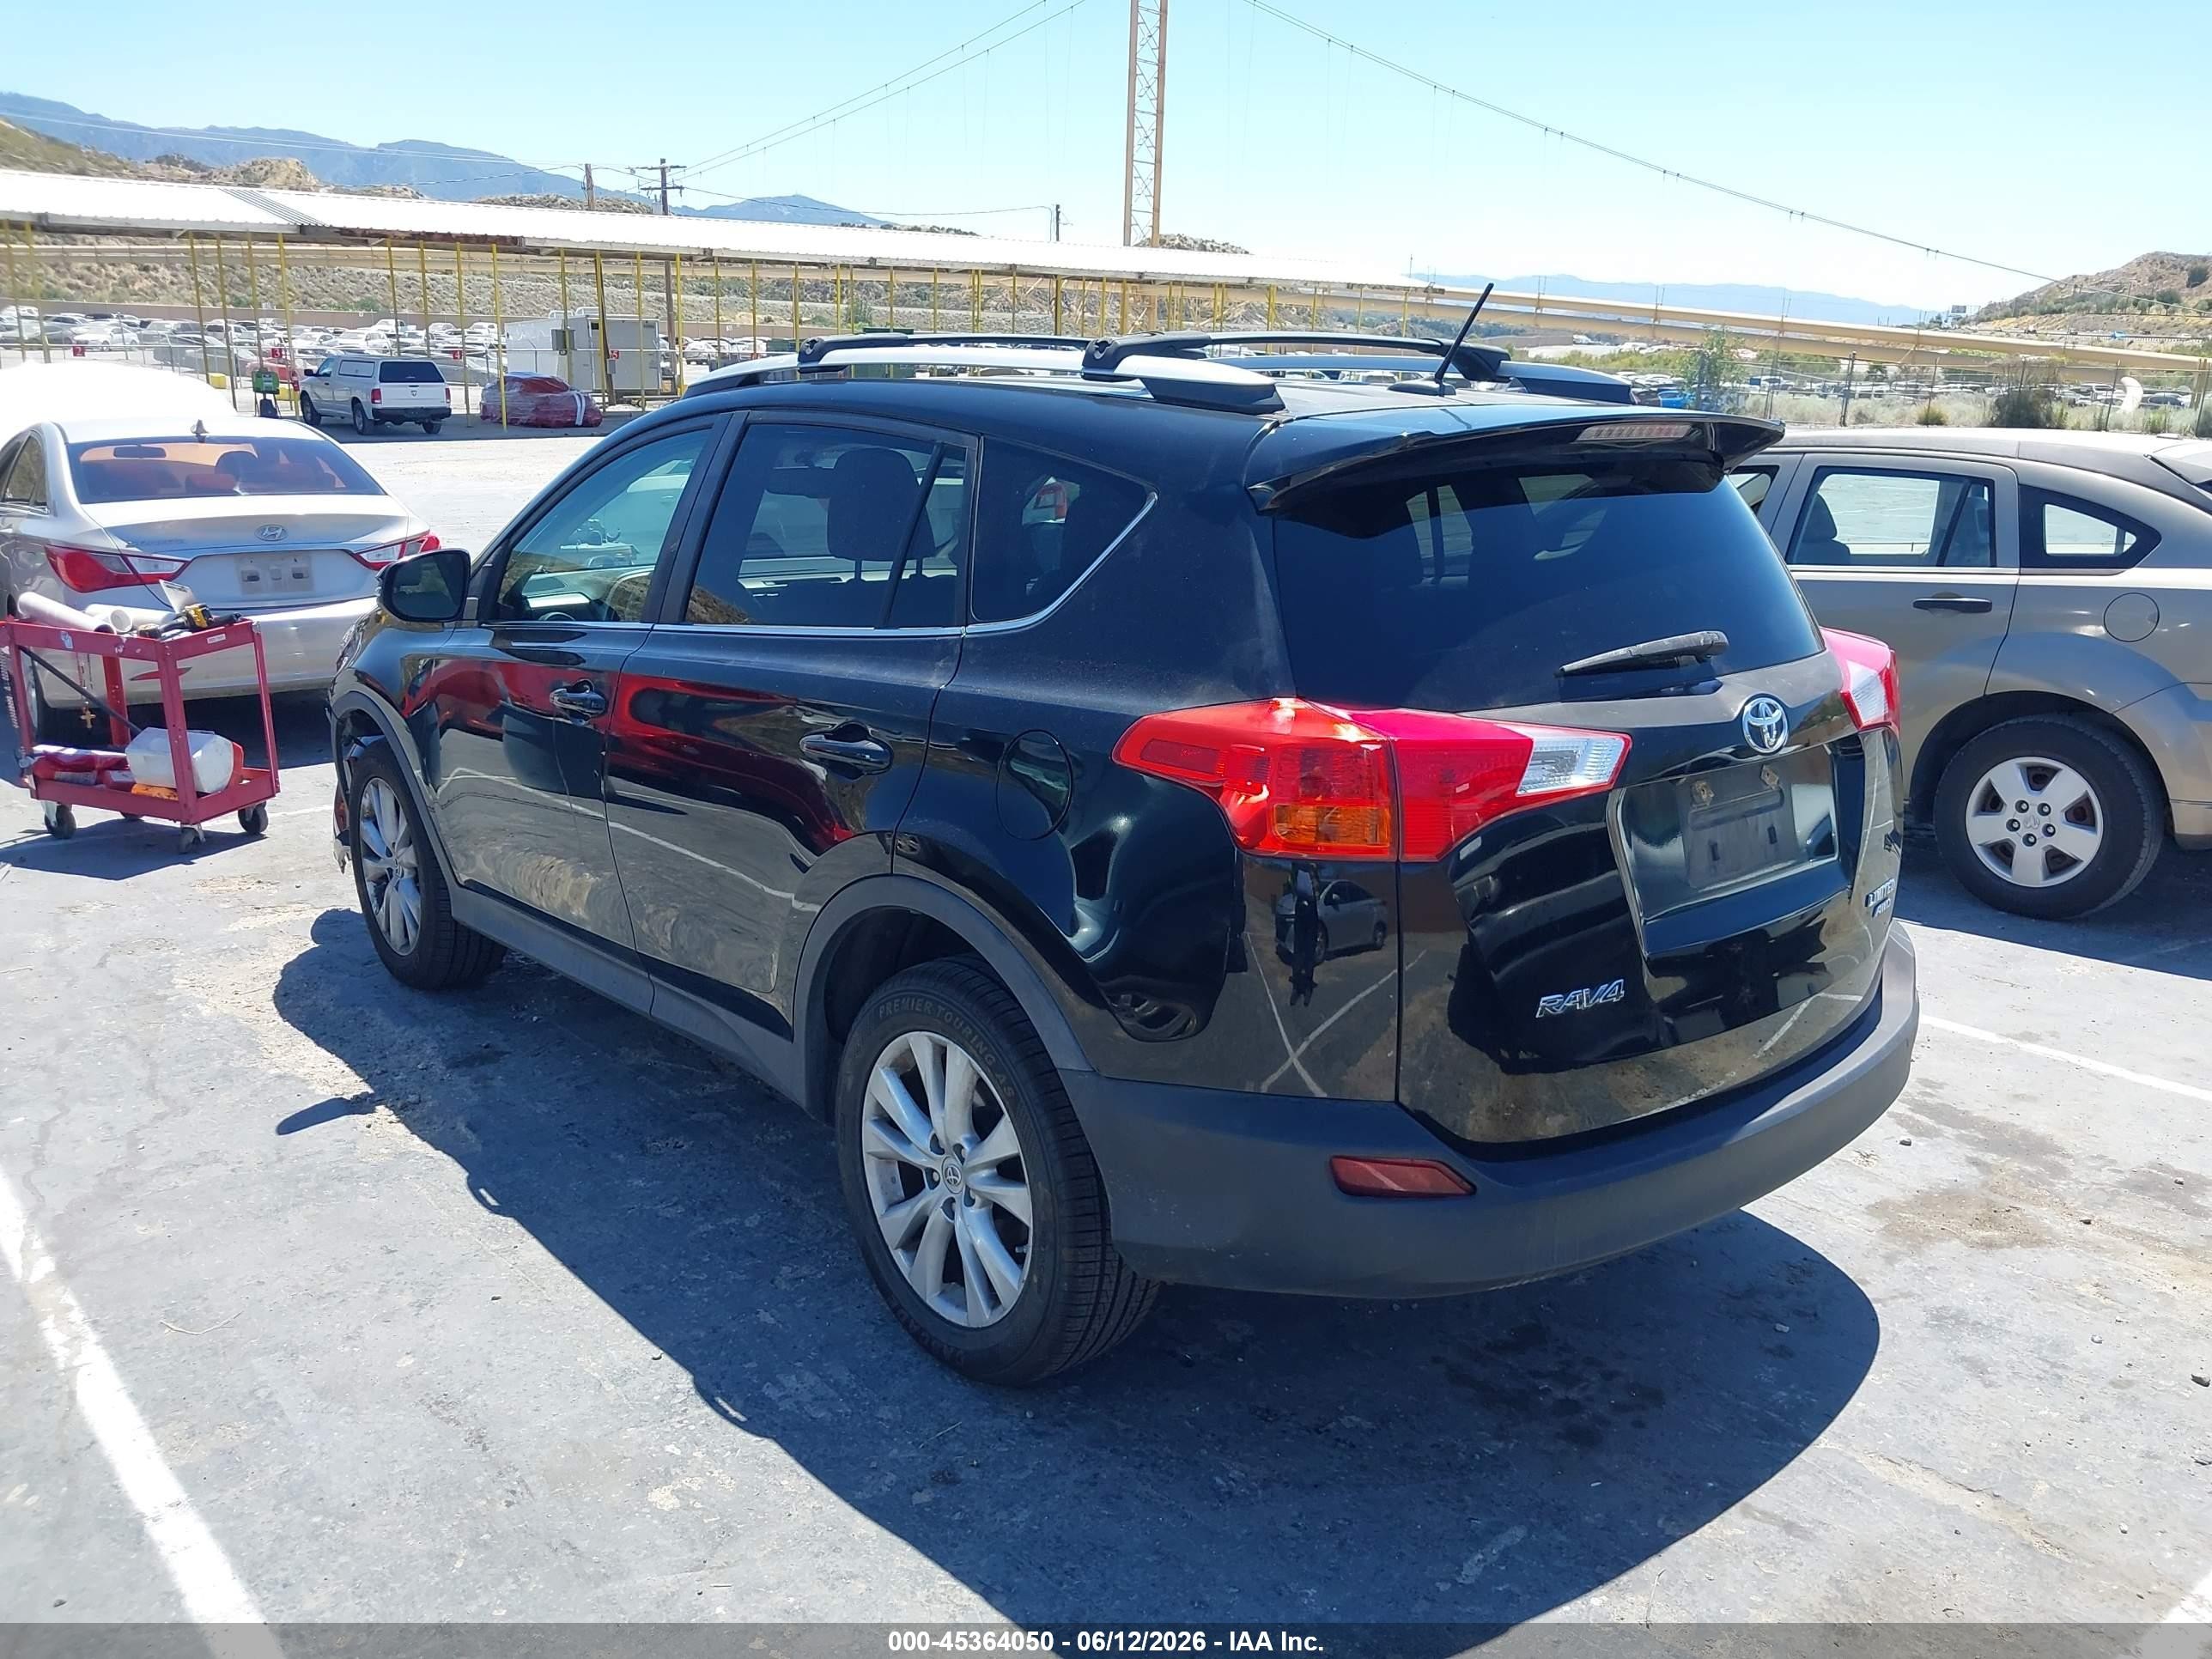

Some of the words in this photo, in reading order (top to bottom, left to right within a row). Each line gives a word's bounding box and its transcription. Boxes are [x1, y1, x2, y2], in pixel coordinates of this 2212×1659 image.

[1866, 878, 1895, 907] LIMITED
[1535, 978, 1626, 1018] RAV4
[878, 997, 933, 1020] PREMIER
[934, 1004, 997, 1066] TOURING
